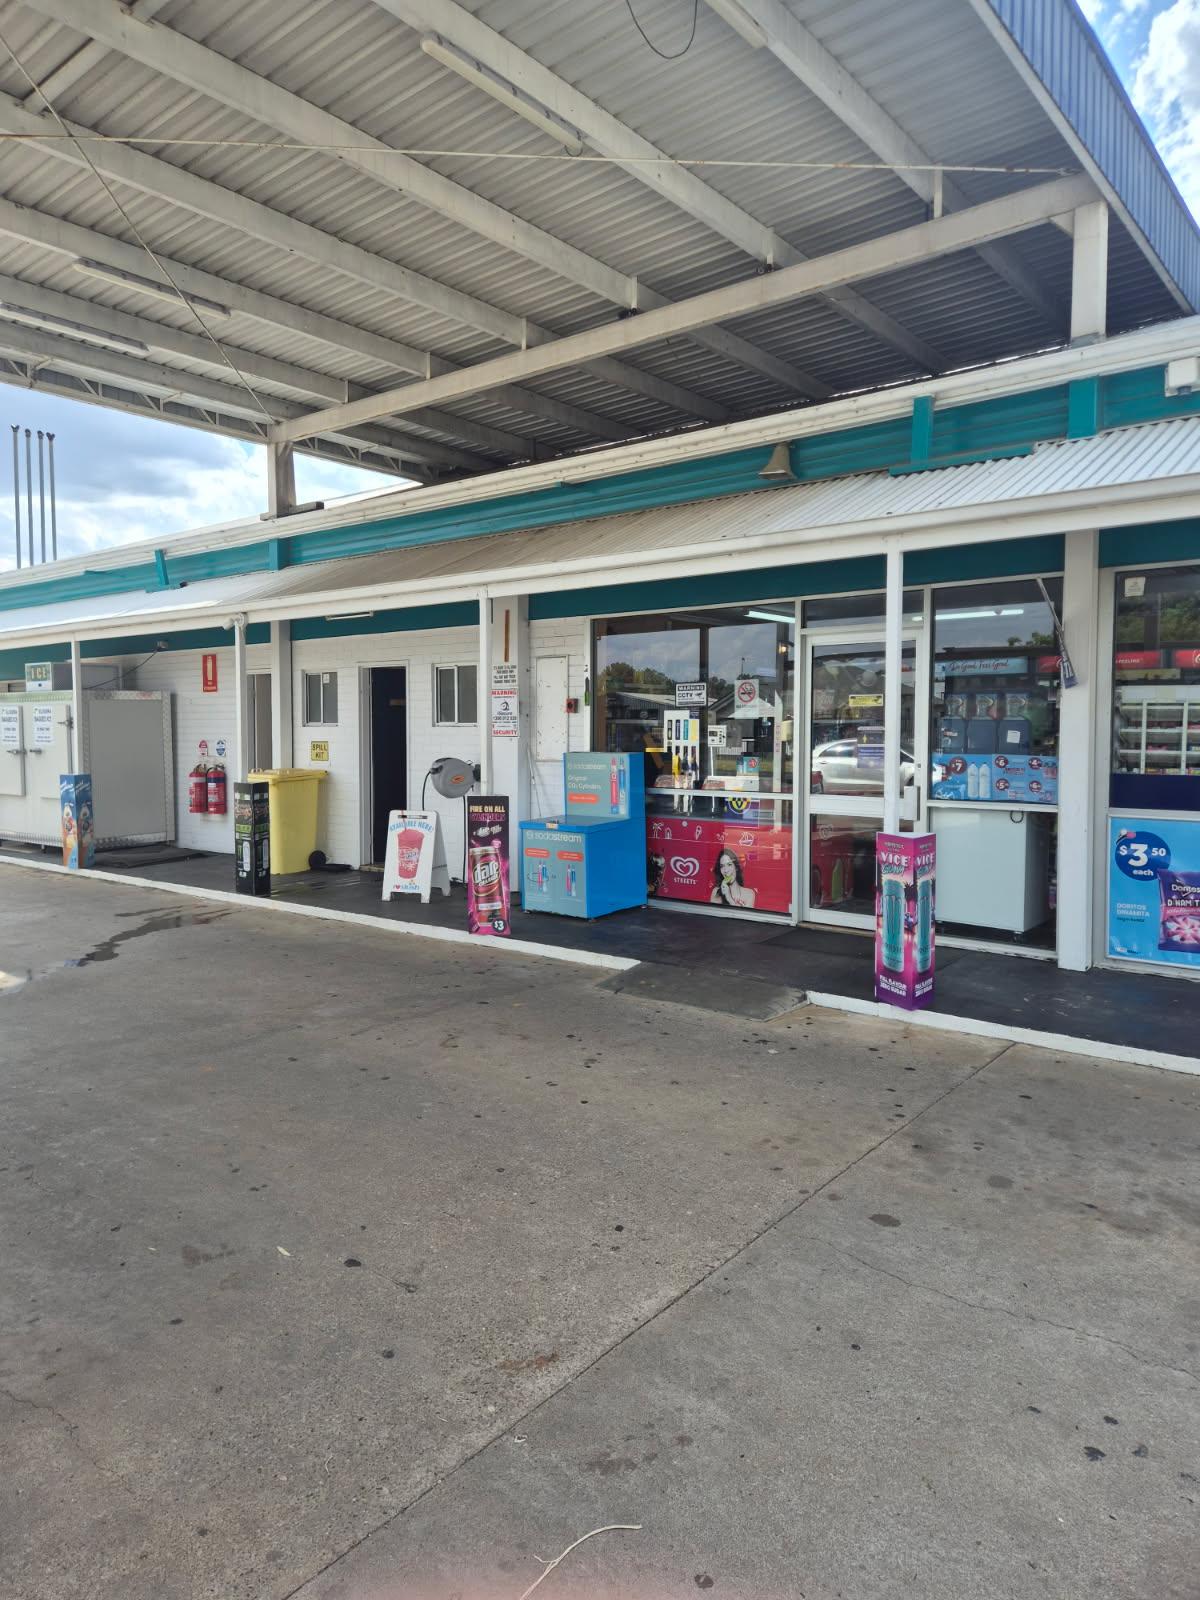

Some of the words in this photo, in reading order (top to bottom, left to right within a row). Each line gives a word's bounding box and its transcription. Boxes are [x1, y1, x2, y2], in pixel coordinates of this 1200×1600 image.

[31, 667, 47, 679] ICE
[677, 684, 704, 692] WARNING
[534, 831, 582, 843] sodastream
[880, 852, 908, 867] VICE
[916, 852, 934, 865] VICE
[673, 877, 697, 885] STREETS
[1116, 902, 1147, 911] DORITOS
[1116, 909, 1151, 917] DINAMITA
[494, 920, 505, 931] $3
